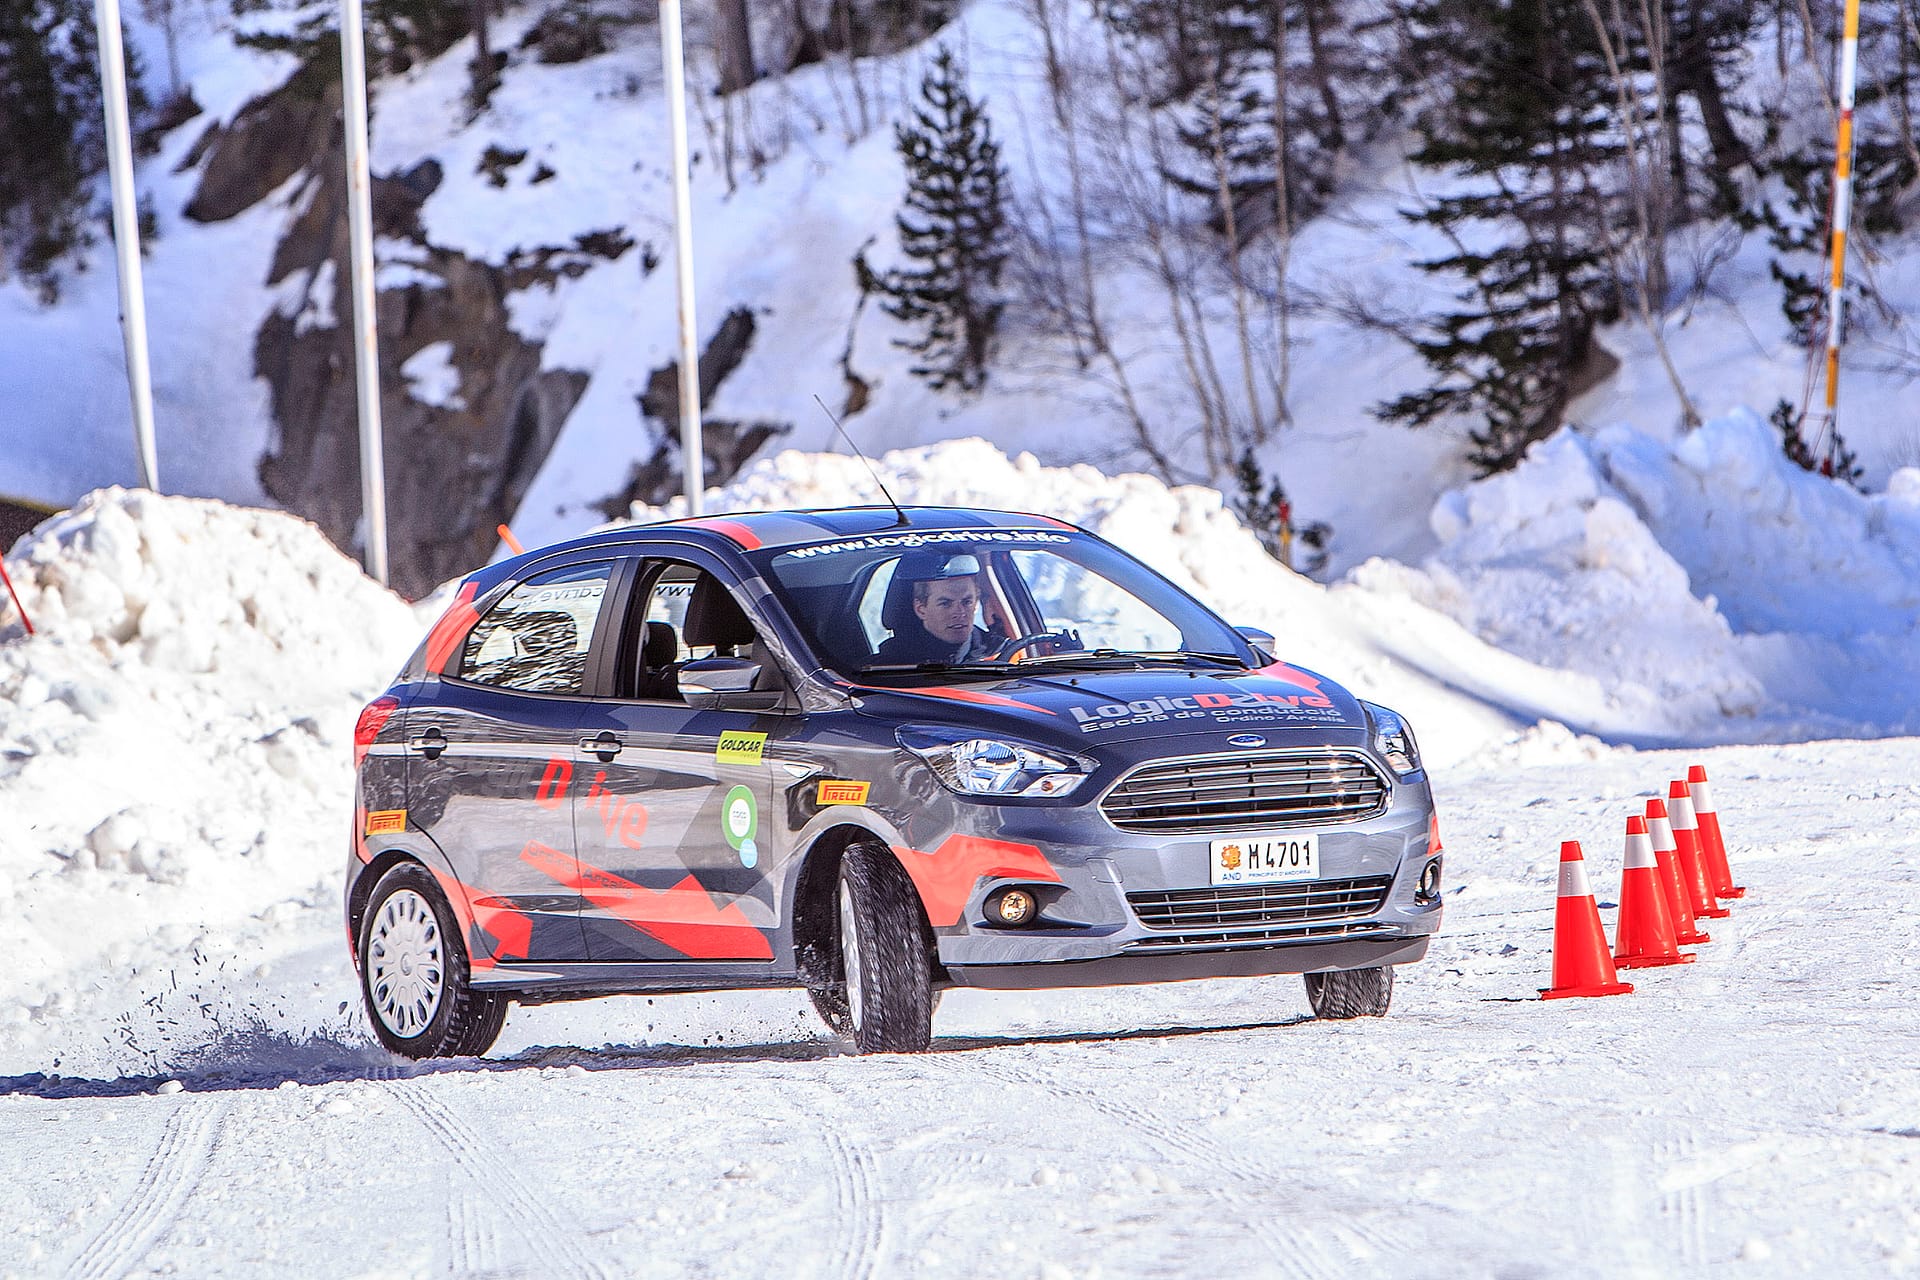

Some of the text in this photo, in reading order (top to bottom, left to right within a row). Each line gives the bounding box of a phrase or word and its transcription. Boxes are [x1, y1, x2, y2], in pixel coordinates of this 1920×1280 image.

[786, 532, 1071, 559] www.logicdrive.info
[1080, 706, 1342, 733] Escola de conducció
[1216, 714, 1275, 722] Ordino
[720, 739, 761, 752] GOLDCAR
[822, 785, 865, 801] PIRELLI
[1222, 872, 1242, 881] AND
